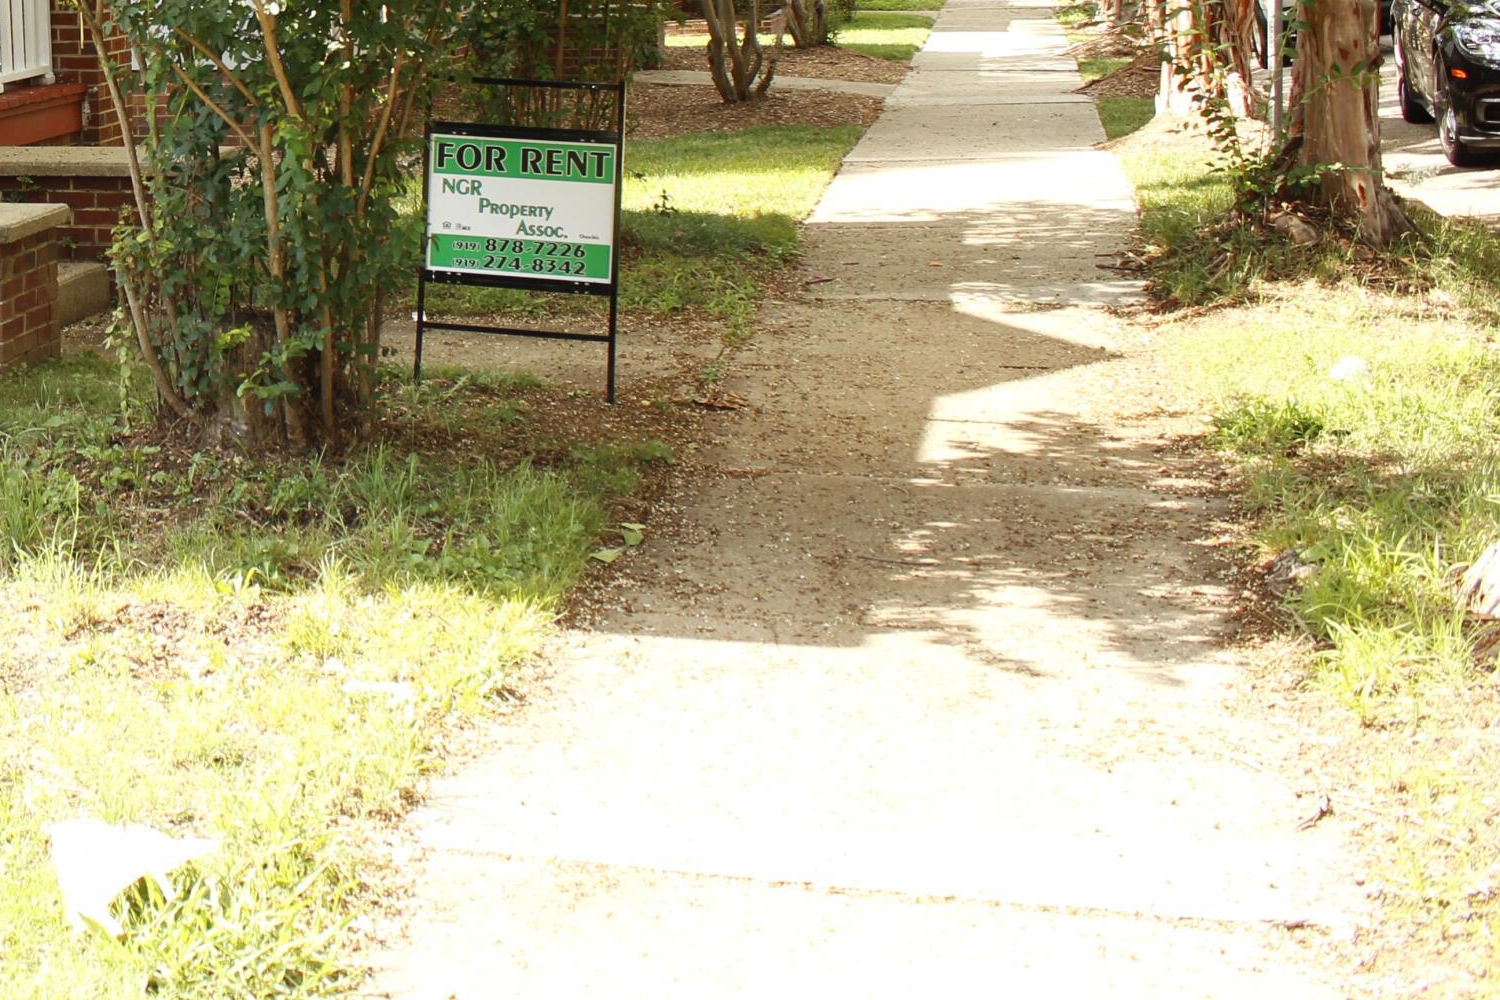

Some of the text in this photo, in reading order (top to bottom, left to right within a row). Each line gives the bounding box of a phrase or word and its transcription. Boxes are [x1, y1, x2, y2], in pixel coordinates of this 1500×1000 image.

[436, 142, 611, 178] FOR RENT
[442, 178, 482, 196] NGR
[452, 238, 586, 258] (919) 878-7226
[452, 255, 586, 275] (919) 274-8342
